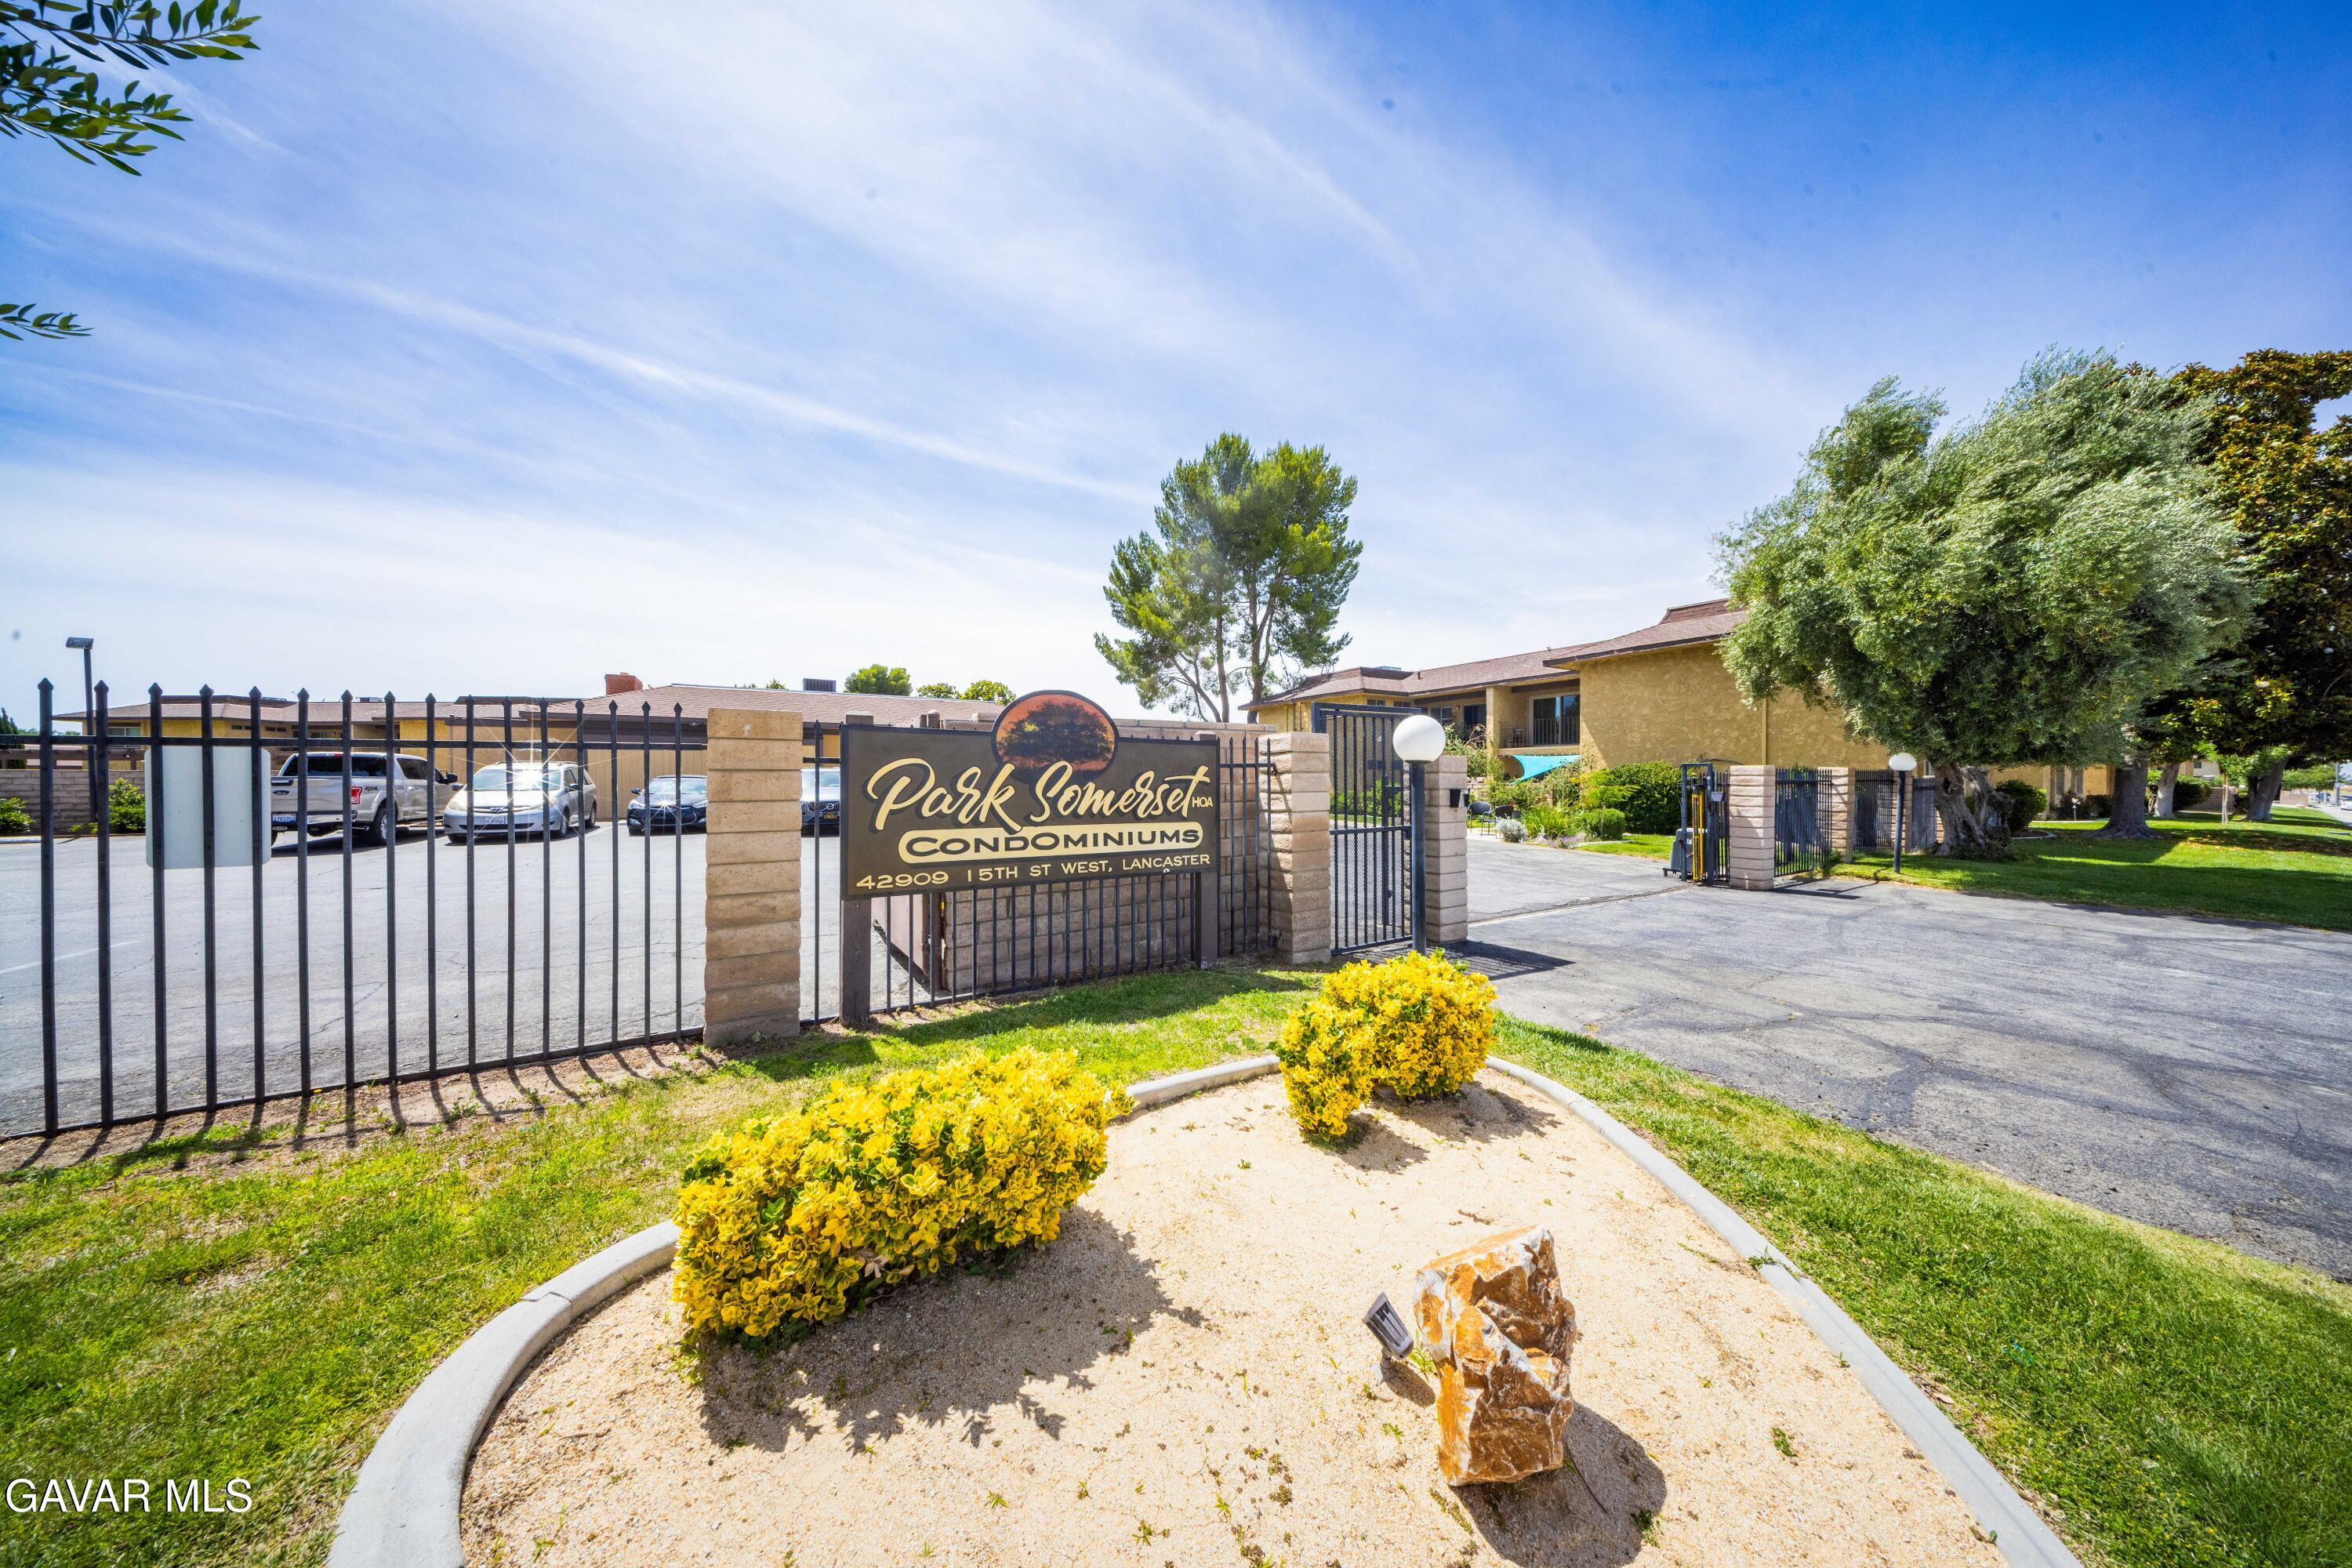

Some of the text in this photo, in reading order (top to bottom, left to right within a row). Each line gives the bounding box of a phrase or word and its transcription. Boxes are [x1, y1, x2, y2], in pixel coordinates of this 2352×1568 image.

[866, 757, 1214, 833] Park Somerset HOA
[906, 829, 1200, 857] CONDOMINIUMS
[855, 871, 949, 890] 42909
[1029, 864, 1051, 877] ST
[1061, 859, 1112, 875] WEST,
[1122, 854, 1210, 871] LANCASTER
